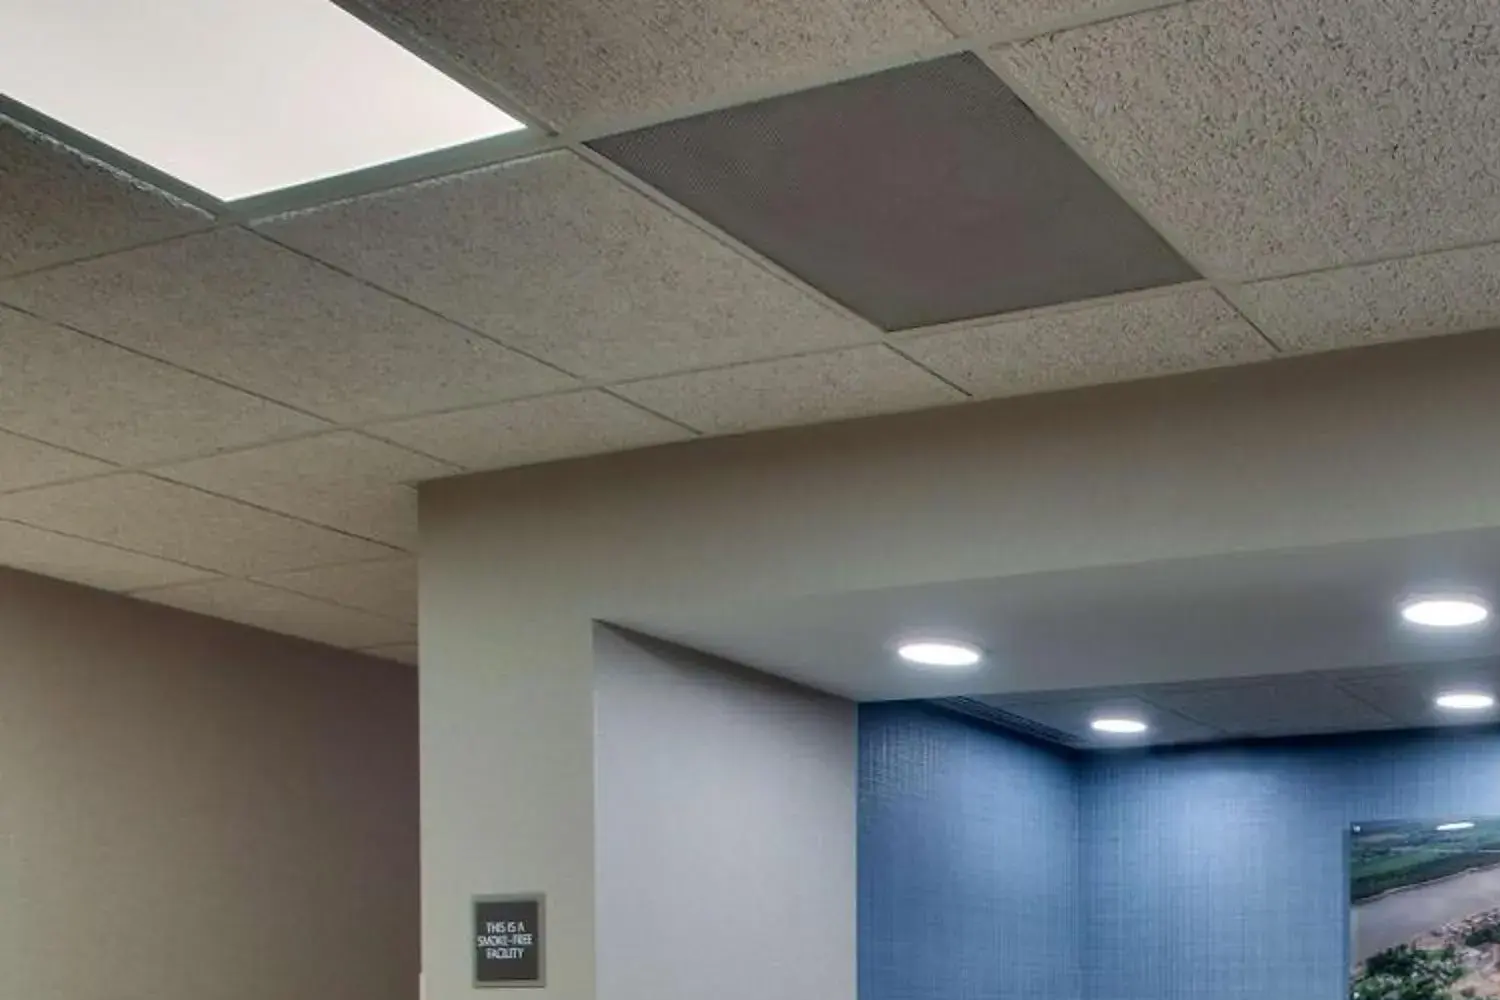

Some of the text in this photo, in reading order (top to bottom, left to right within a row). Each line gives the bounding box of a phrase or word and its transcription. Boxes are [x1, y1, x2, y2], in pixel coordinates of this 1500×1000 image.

[486, 921, 526, 933] THIS IS A
[486, 947, 525, 959] FACILITY
